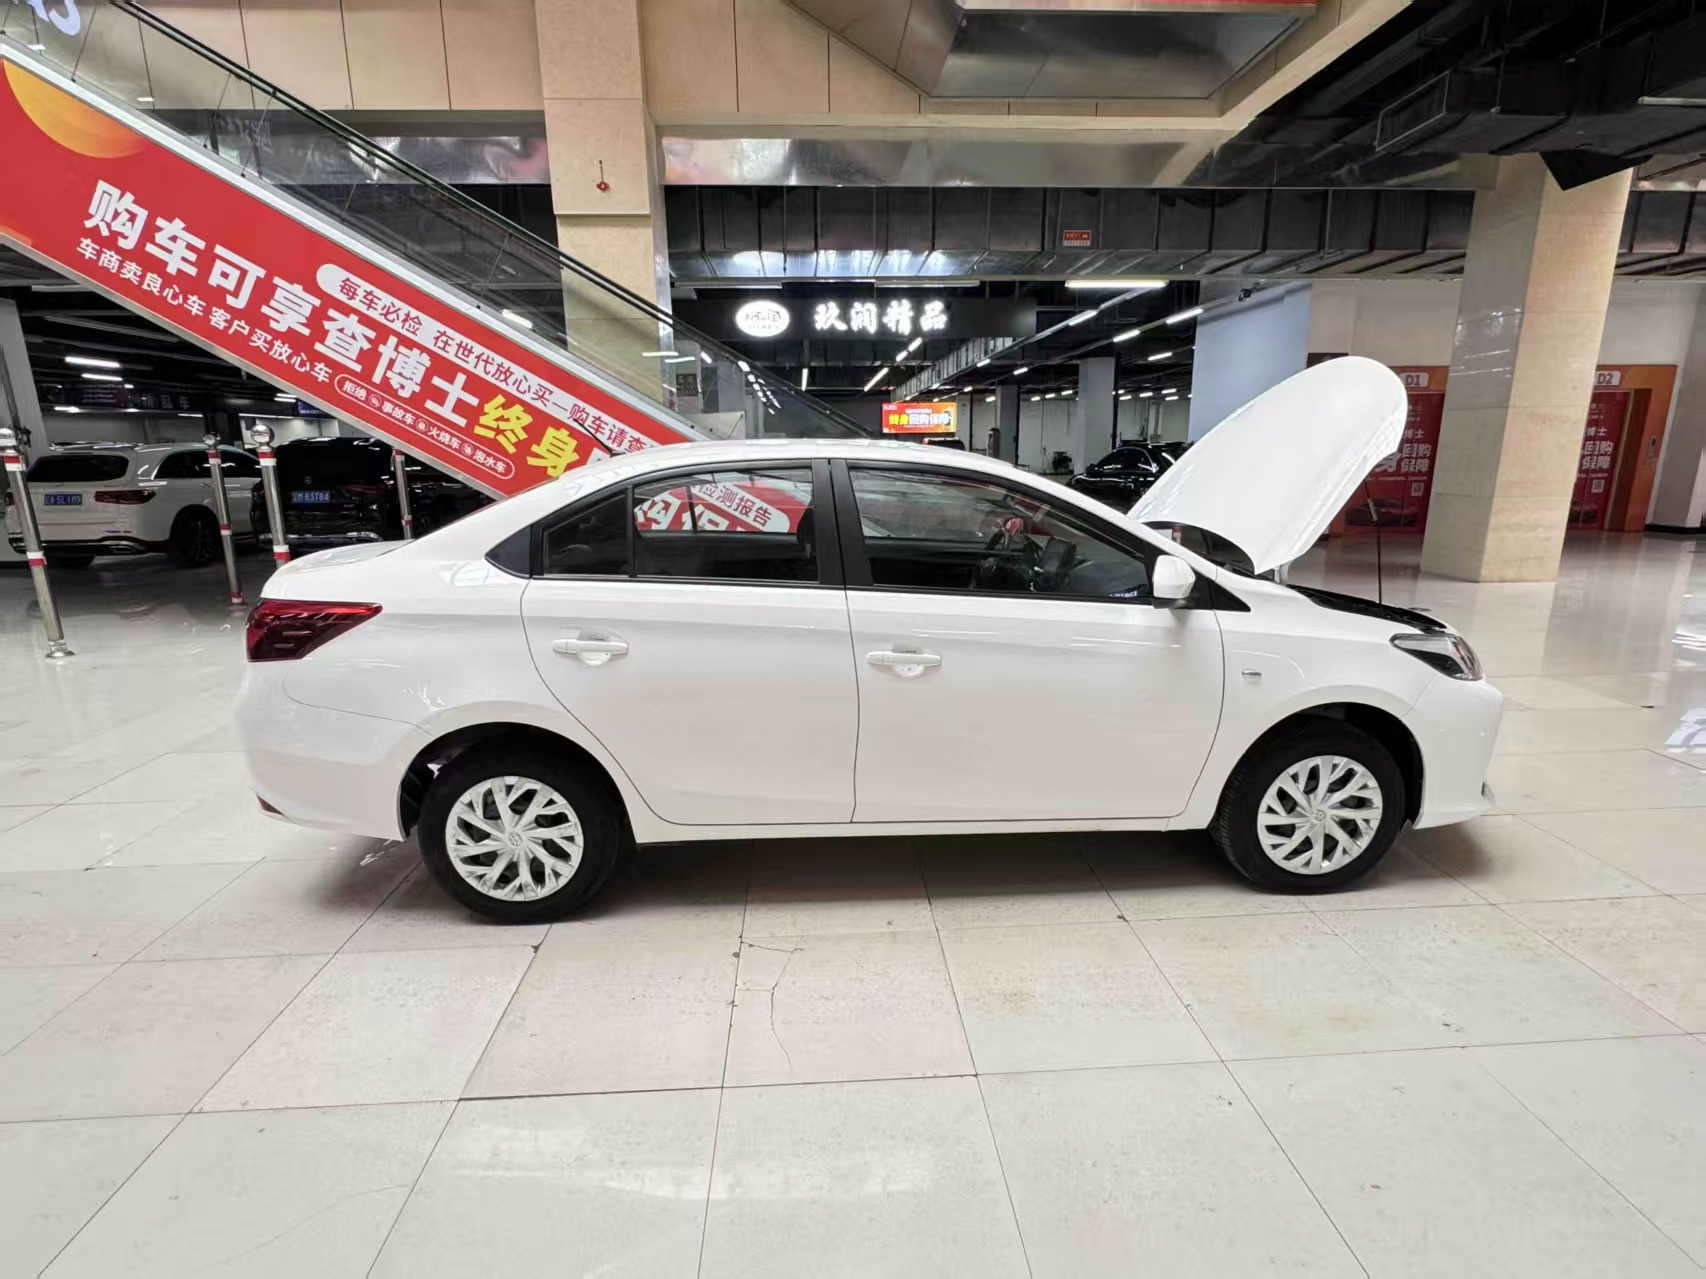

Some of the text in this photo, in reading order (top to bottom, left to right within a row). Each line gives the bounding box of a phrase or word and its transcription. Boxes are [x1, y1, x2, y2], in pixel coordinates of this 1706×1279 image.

[76, 237, 333, 384] 车商卖良心车 客户买放心车
[339, 277, 424, 337] 每车必检
[1405, 374, 1421, 386] D1
[1597, 372, 1613, 385] D2
[342, 379, 507, 474] 拒绝 事故车 火烧车 泡水车
